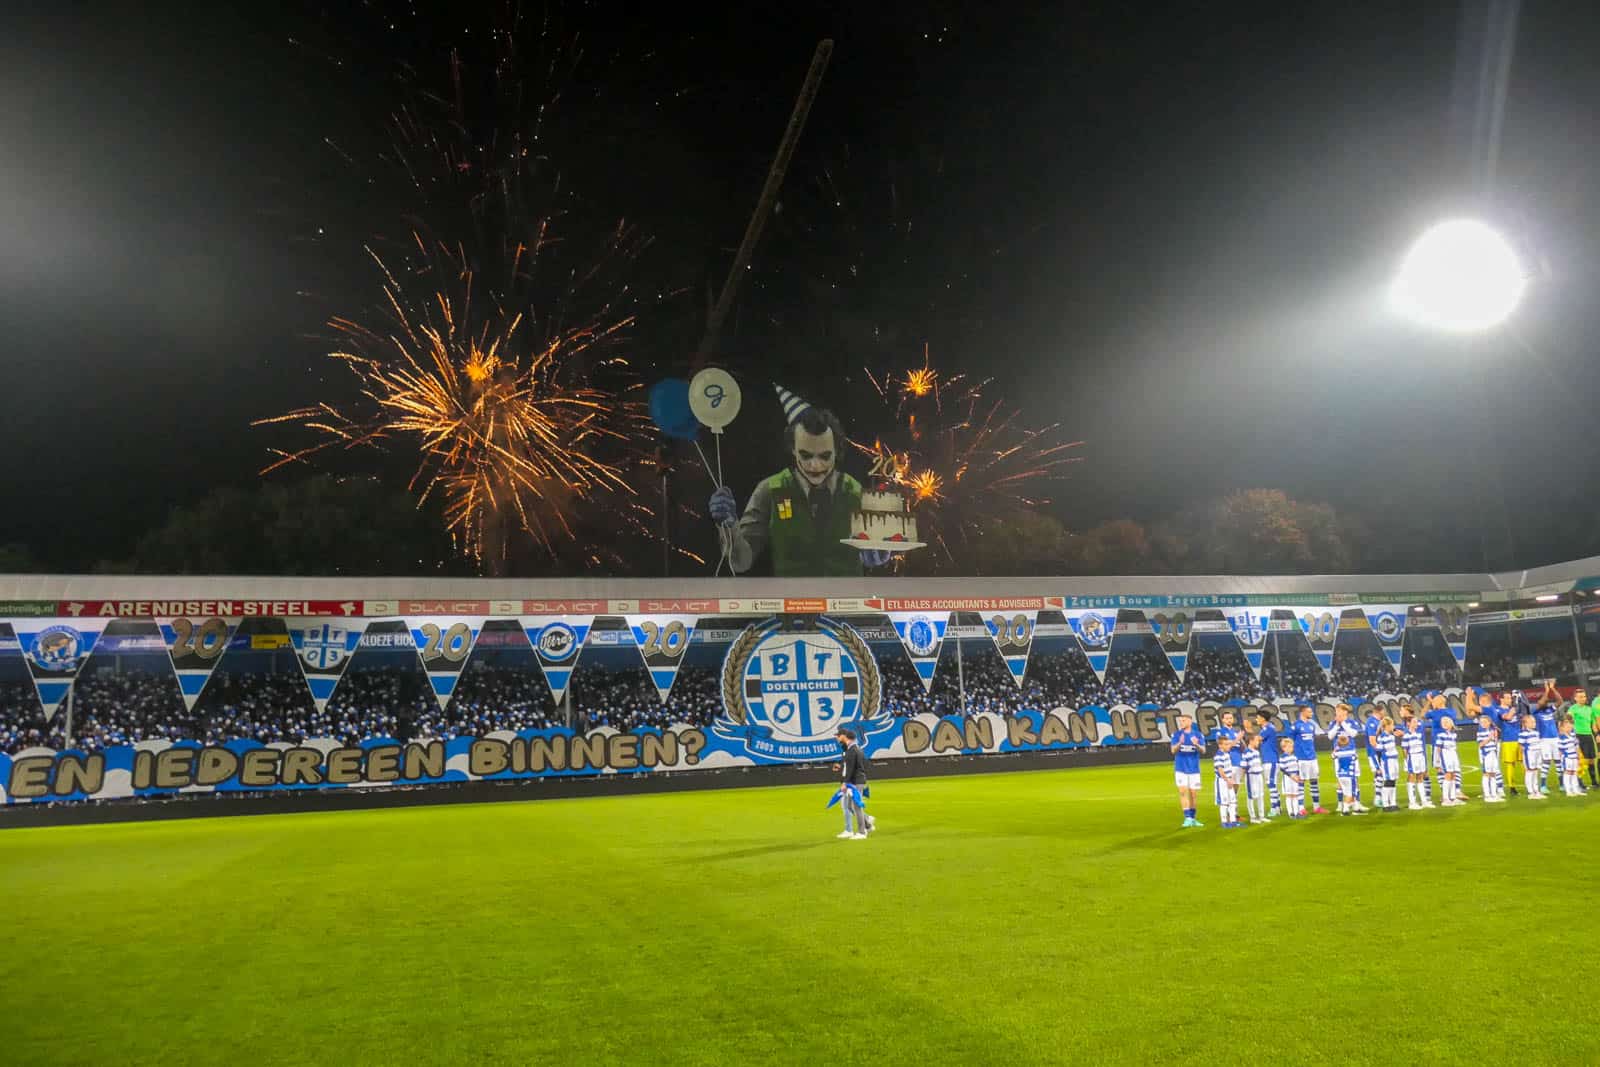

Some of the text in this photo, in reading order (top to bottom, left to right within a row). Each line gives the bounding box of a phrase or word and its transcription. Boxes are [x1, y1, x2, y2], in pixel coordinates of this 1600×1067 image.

[98, 601, 317, 616] ARENDSEN-STEEL
[887, 599, 1041, 609] ETL DALES ACCOUNTANTS & ADVISEURS
[1071, 596, 1152, 607] Zegers Bouw
[1167, 596, 1208, 606] Zegers
[171, 616, 227, 659] 20
[640, 620, 687, 657] 20
[992, 614, 1031, 647] 20
[1303, 612, 1335, 643] 20
[421, 622, 473, 662] 20
[329, 650, 338, 661] 3
[769, 652, 833, 676] B T
[766, 682, 839, 691] DOETINCHEM
[815, 696, 835, 721] 3
[8, 754, 105, 798] EN
[130, 740, 446, 790] IEDEREEN
[469, 729, 707, 776] BINNEN?
[902, 715, 995, 754] DAN
[1008, 710, 1098, 748] KAN
[1110, 708, 1182, 741] HET
[812, 742, 838, 753] TIFOSI
